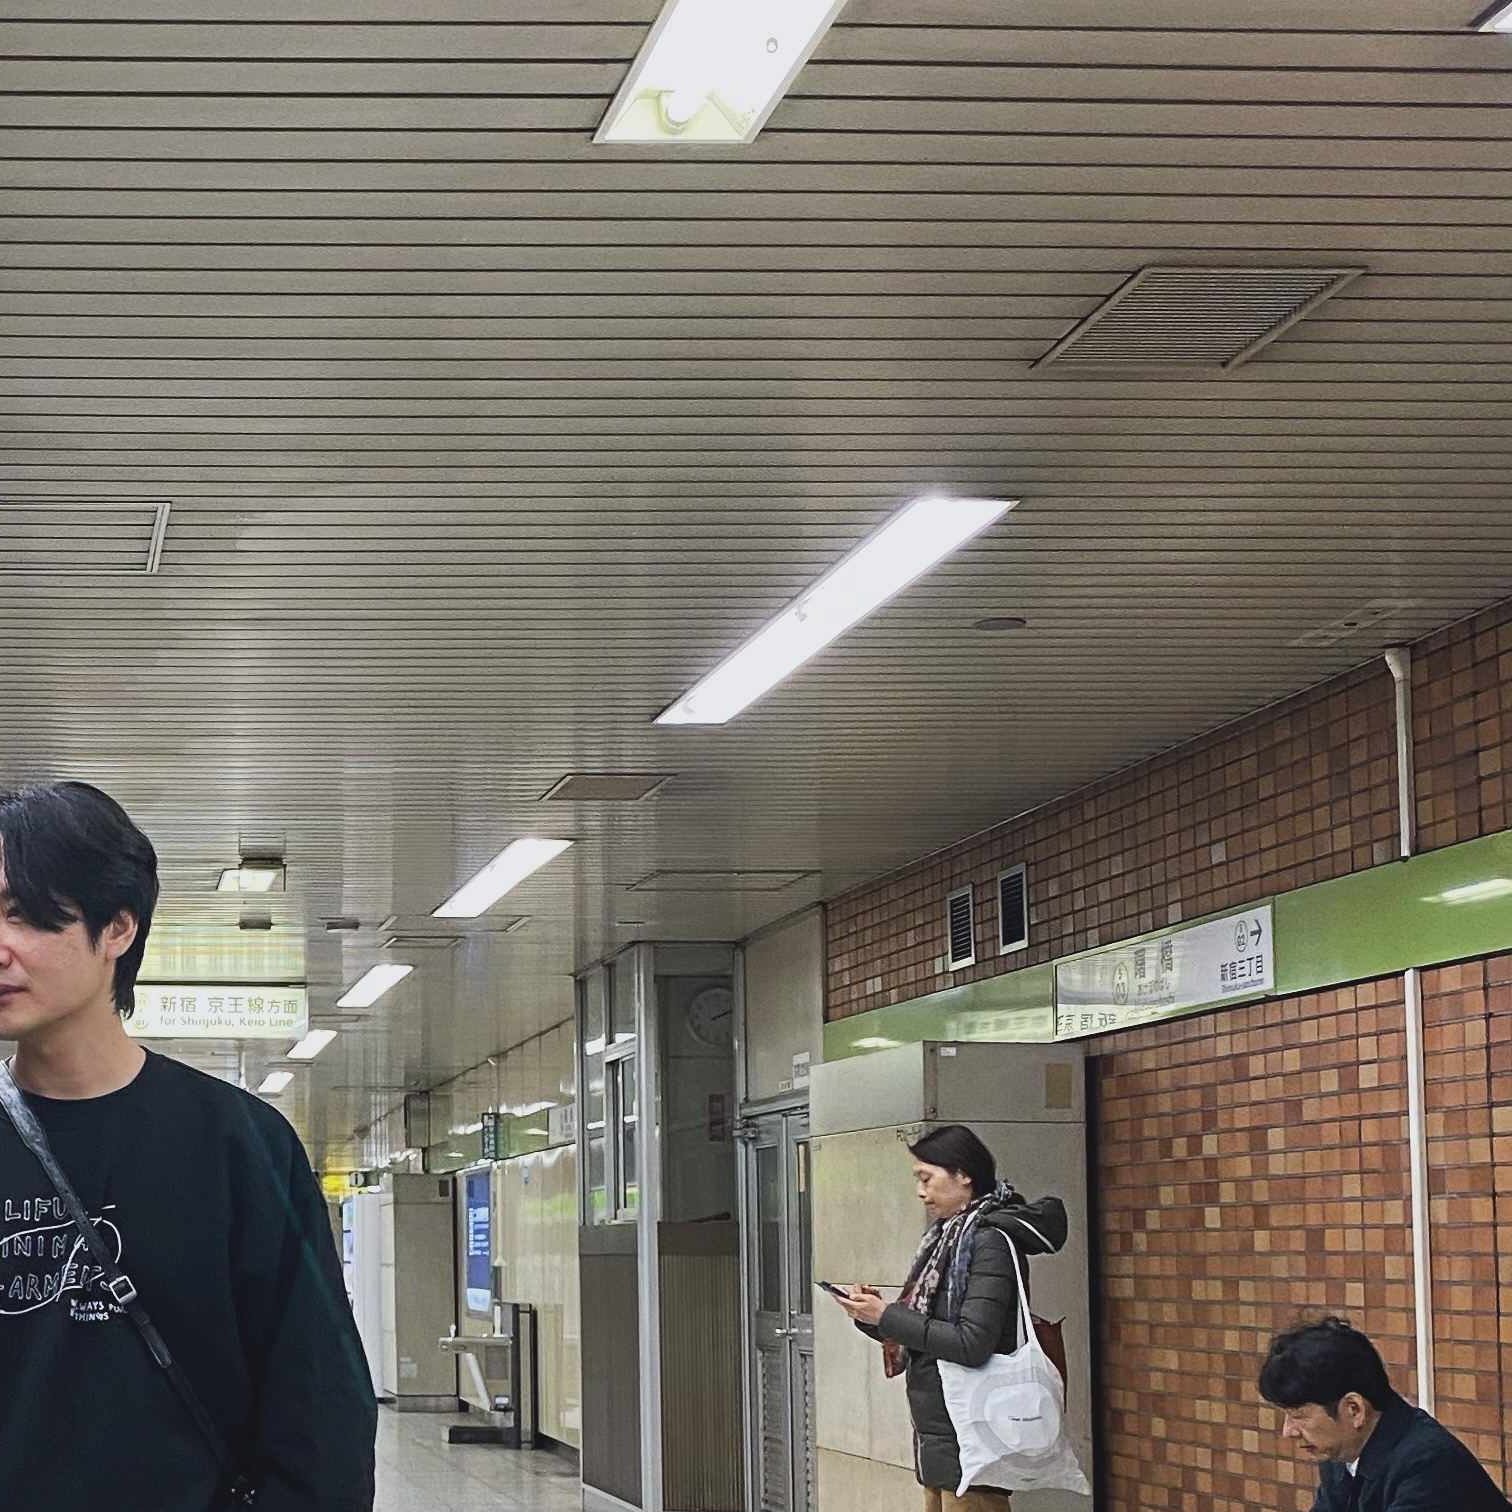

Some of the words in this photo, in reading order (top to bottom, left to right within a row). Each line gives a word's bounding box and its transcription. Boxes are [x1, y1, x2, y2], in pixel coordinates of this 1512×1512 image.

[1219, 954, 1263, 982] 新宿三丁目
[160, 996, 197, 1013] 新宿
[207, 996, 298, 1014] 京王線方面
[160, 1015, 176, 1026] for
[180, 1016, 235, 1028] Shinjuku,
[269, 1017, 293, 1027] Line
[4, 1197, 88, 1222] LIFU
